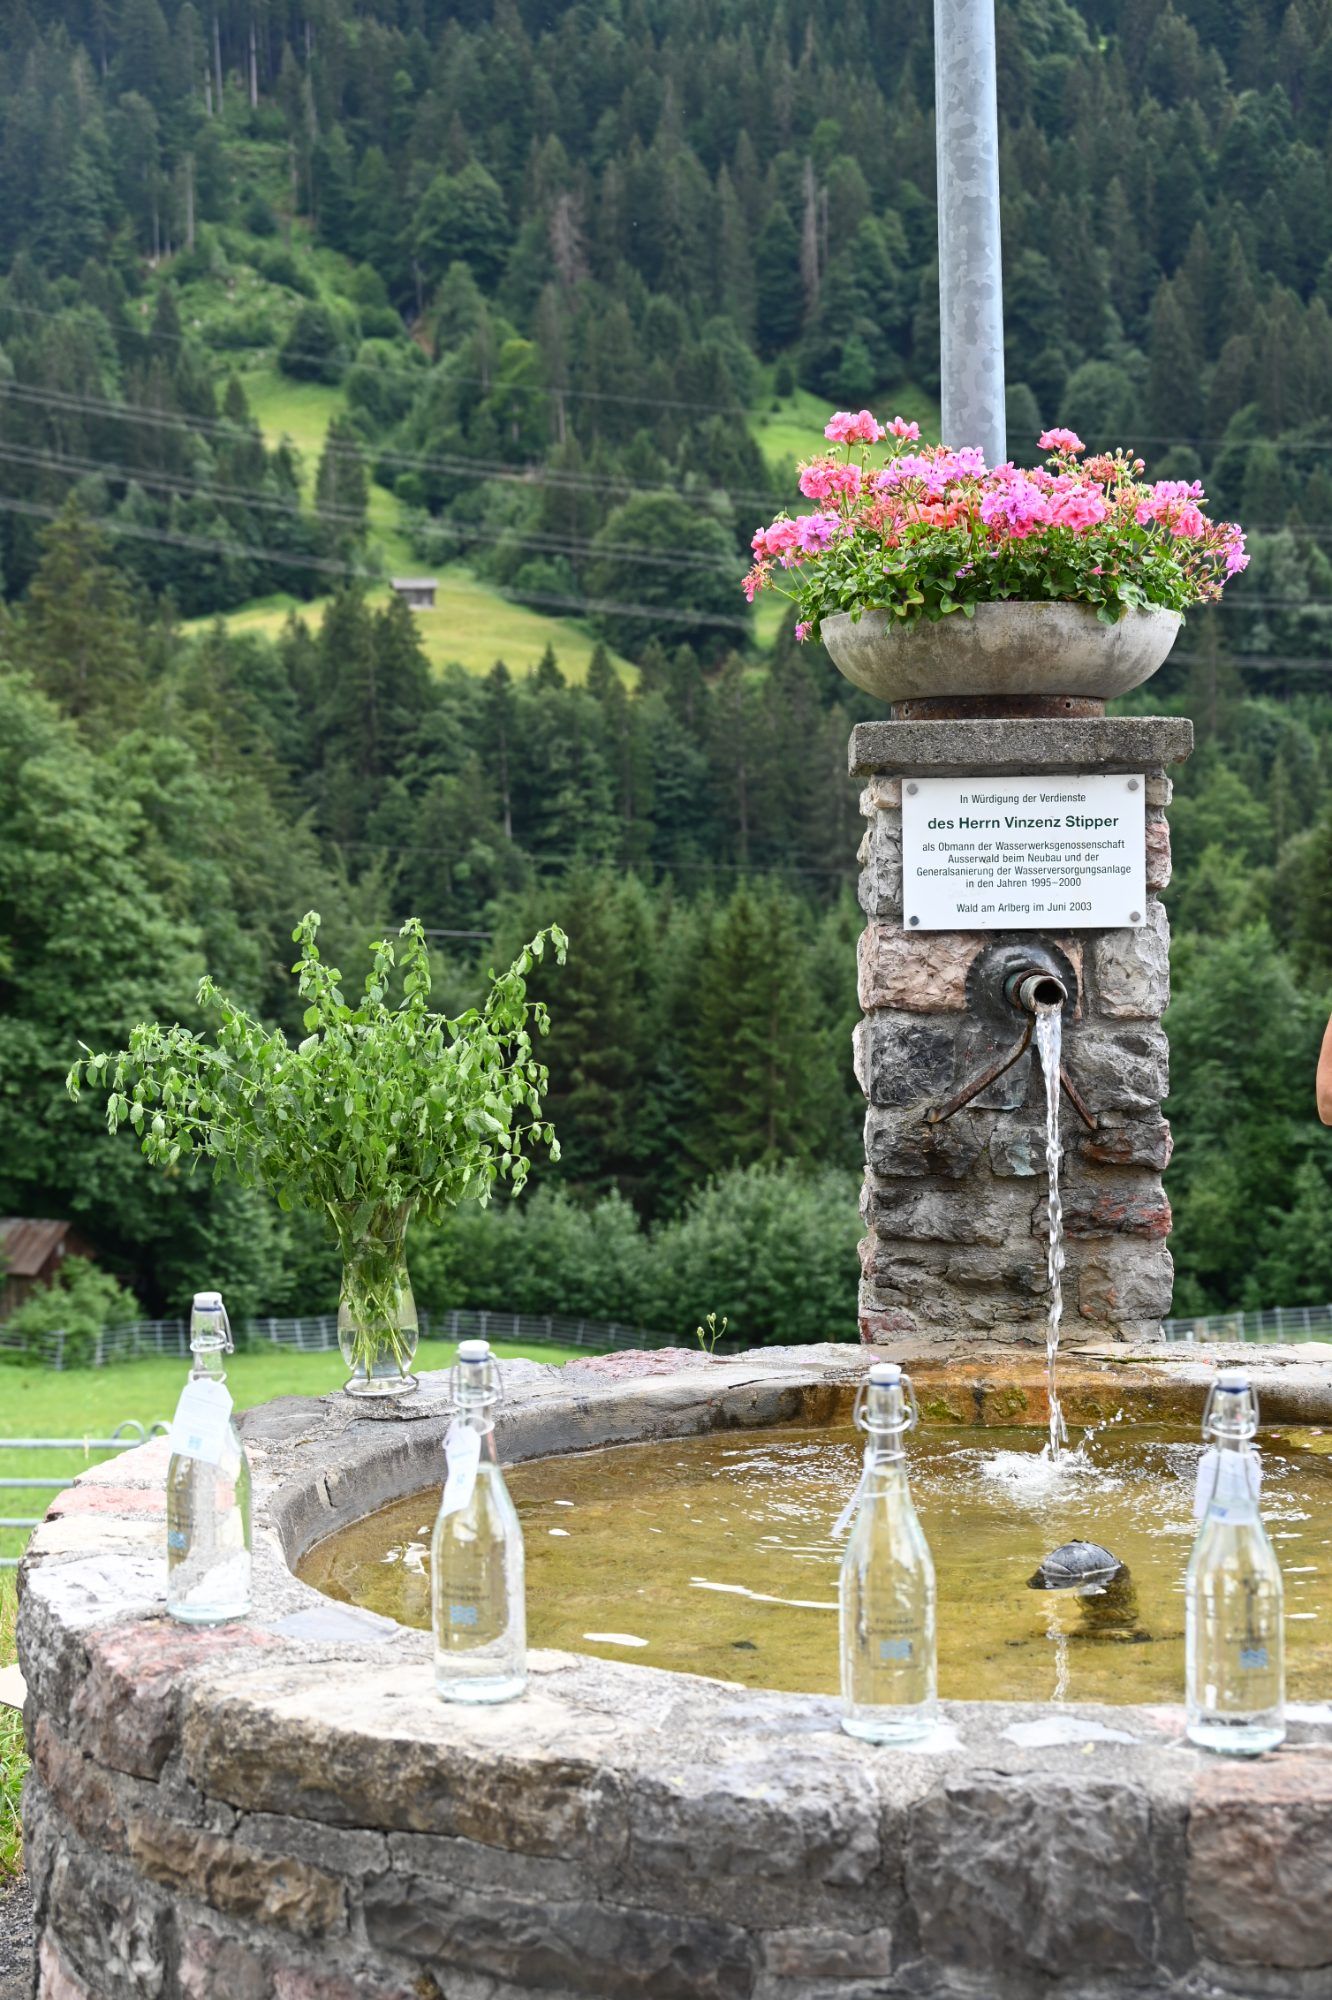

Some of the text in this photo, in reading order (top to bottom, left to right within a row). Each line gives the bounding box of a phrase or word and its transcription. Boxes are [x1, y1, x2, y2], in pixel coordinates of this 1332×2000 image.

[959, 792, 1087, 806] In Würdigung der Verdienste
[928, 814, 1120, 831] des Herrn Vinzenz Stipper
[923, 839, 1126, 852] als Obmann der Wasserwerksgenossenschaft
[948, 852, 1100, 865] Ausserwald beim Neubau und der
[917, 864, 1132, 877] Generalsanierung der Wasserversorgungsanlage
[965, 878, 975, 888] in
[978, 878, 994, 888] den
[997, 878, 1028, 888] Jahren
[957, 901, 1093, 914] Wald am Arlberg im Juni 2003
